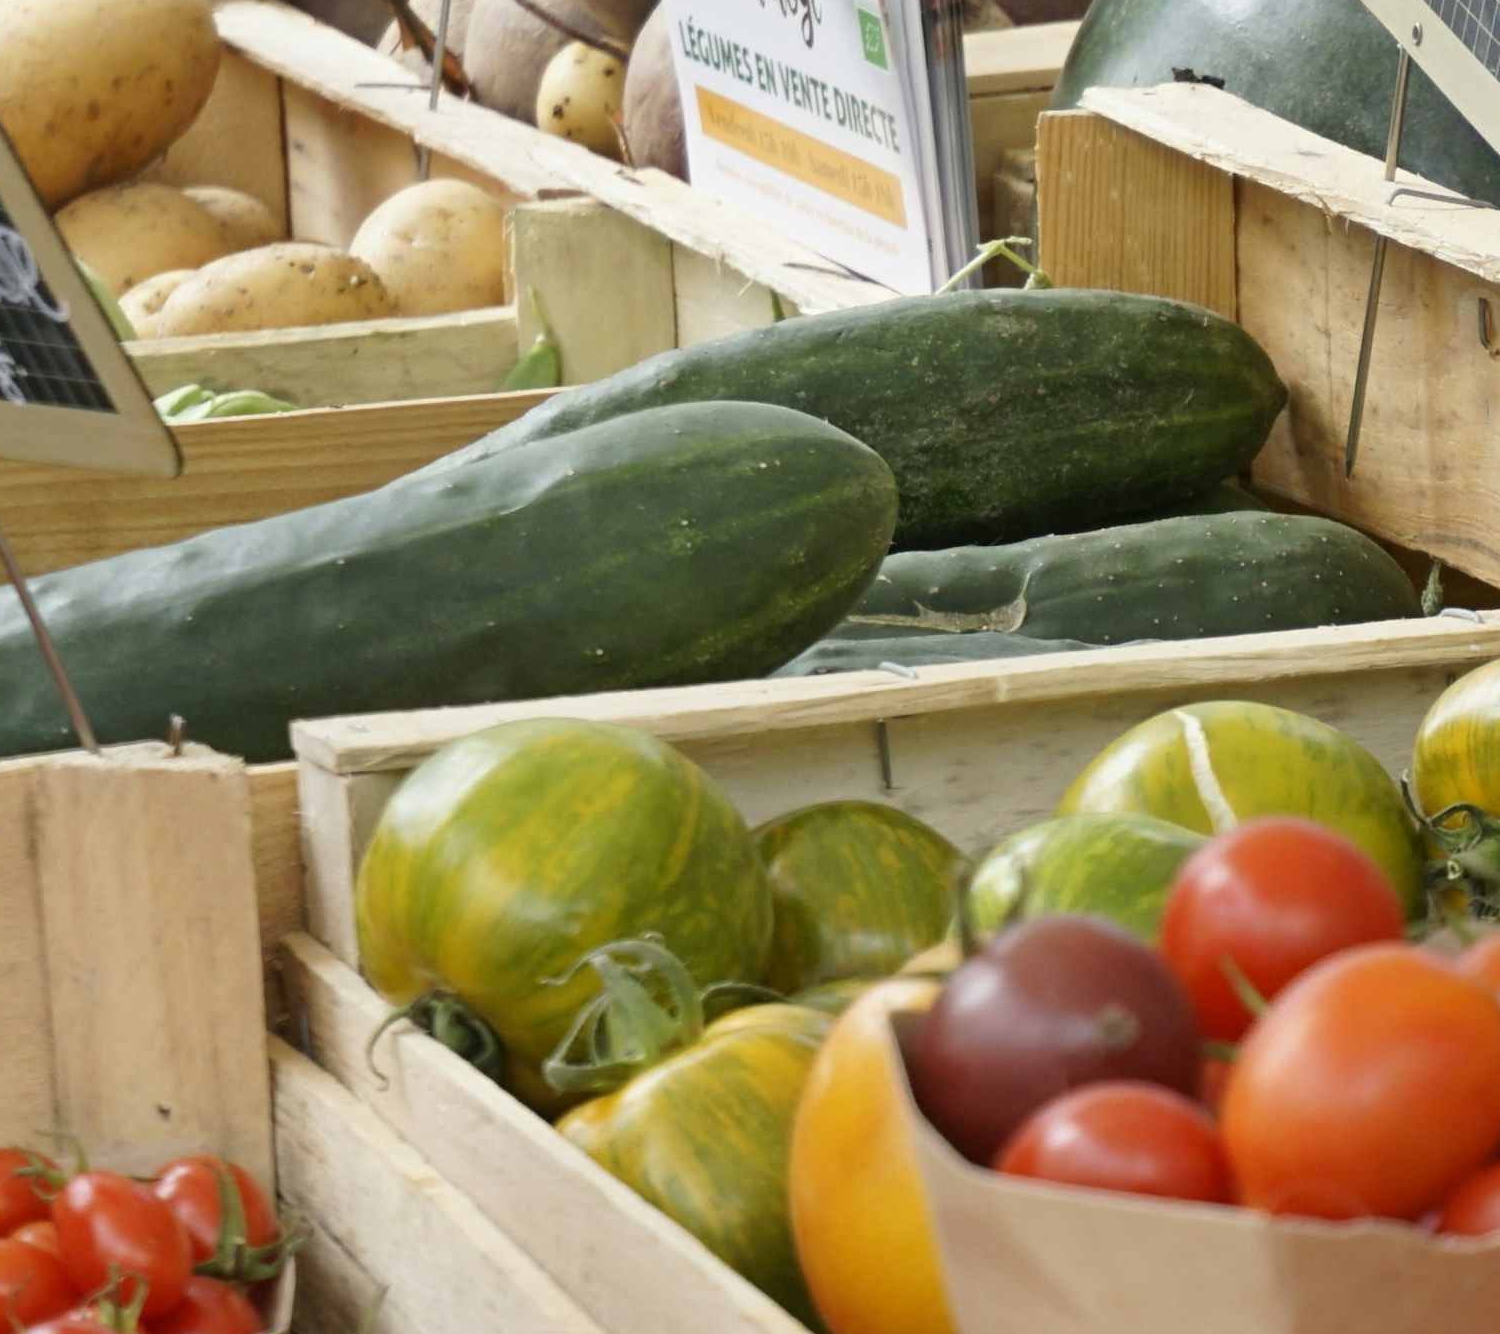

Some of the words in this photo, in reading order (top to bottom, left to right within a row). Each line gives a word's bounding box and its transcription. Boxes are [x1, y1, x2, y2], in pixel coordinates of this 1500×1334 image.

[678, 16, 753, 85] LÉGUMES
[754, 51, 778, 96] EN
[778, 61, 833, 121] VENTE
[833, 85, 901, 154] DIRECTE
